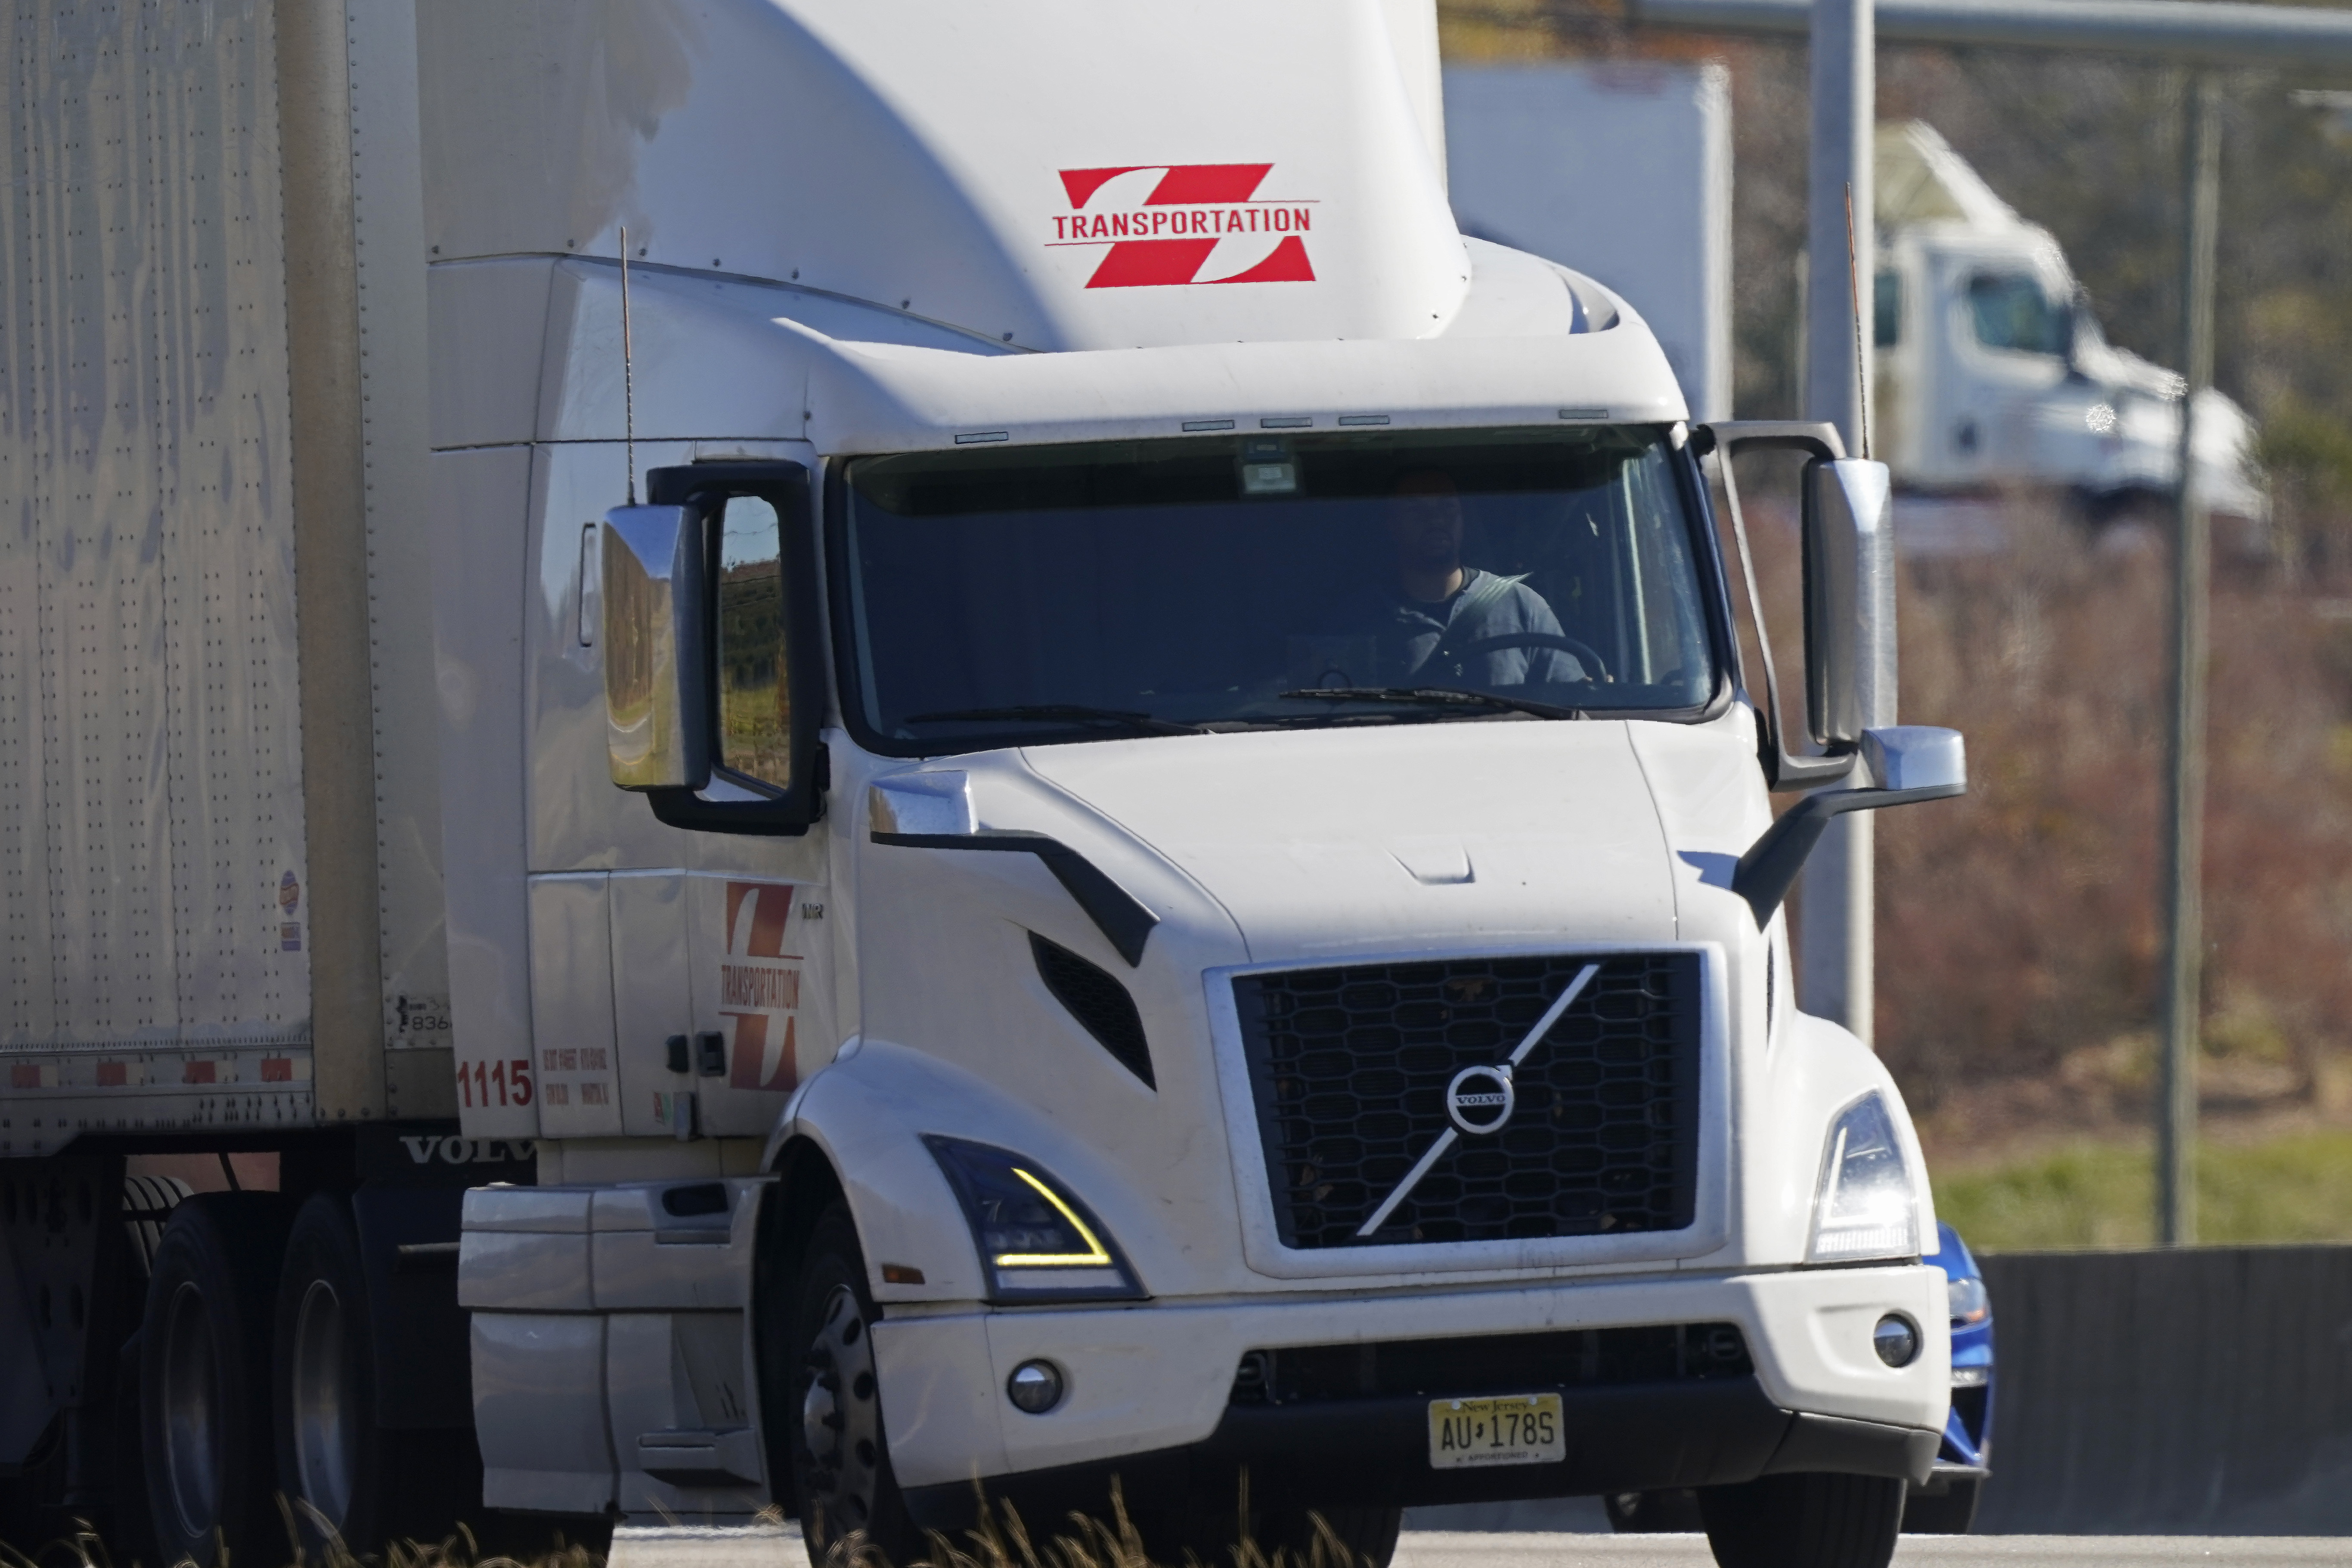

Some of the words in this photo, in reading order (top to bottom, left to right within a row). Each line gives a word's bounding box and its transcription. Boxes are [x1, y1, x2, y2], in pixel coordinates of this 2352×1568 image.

[1052, 208, 1311, 239] TRANSPORTATION
[412, 1015, 452, 1031] 836
[456, 1060, 533, 1108] 1115
[1456, 1094, 1506, 1104] VOLVO
[399, 1135, 536, 1164] VOLV
